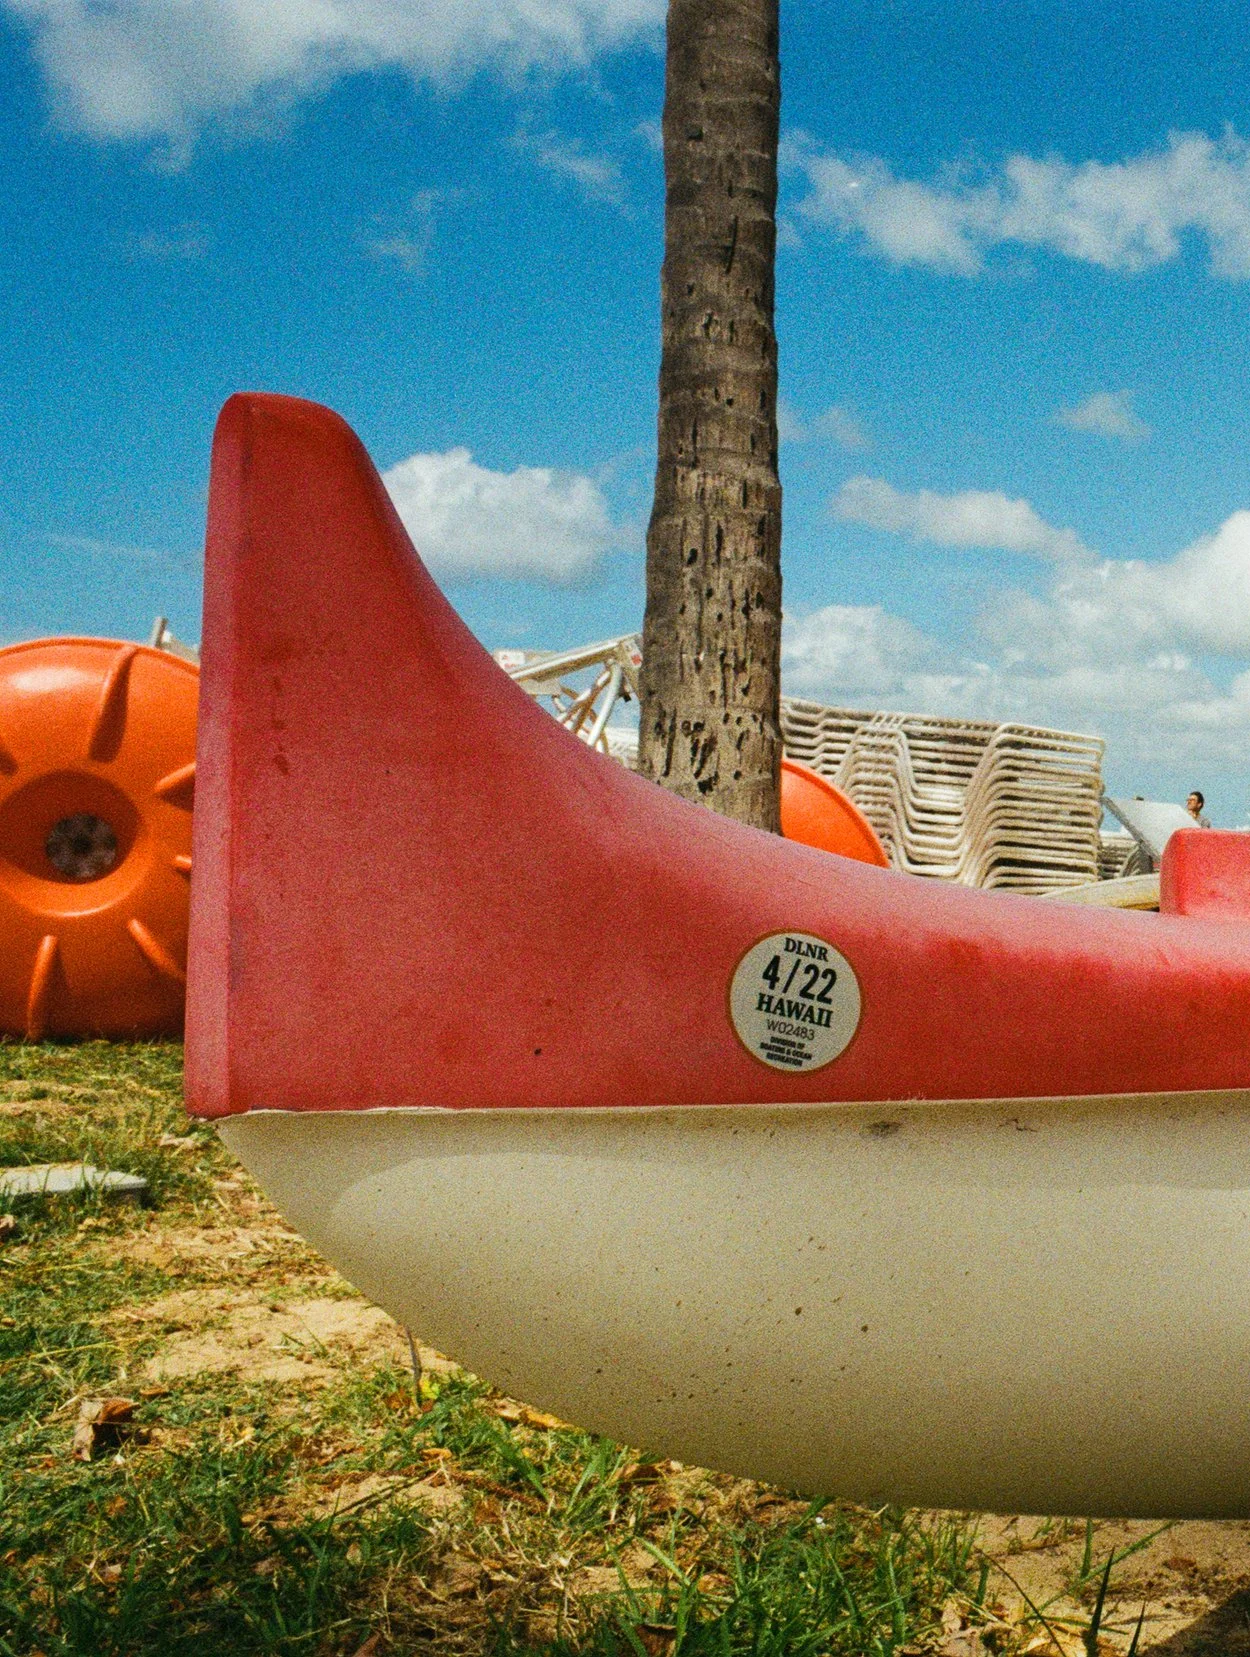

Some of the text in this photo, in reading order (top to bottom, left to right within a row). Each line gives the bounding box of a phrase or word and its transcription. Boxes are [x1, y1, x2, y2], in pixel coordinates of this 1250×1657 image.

[783, 937, 828, 962] DLNR
[762, 955, 838, 1005] 4/22
[755, 992, 834, 1029] HAWAII
